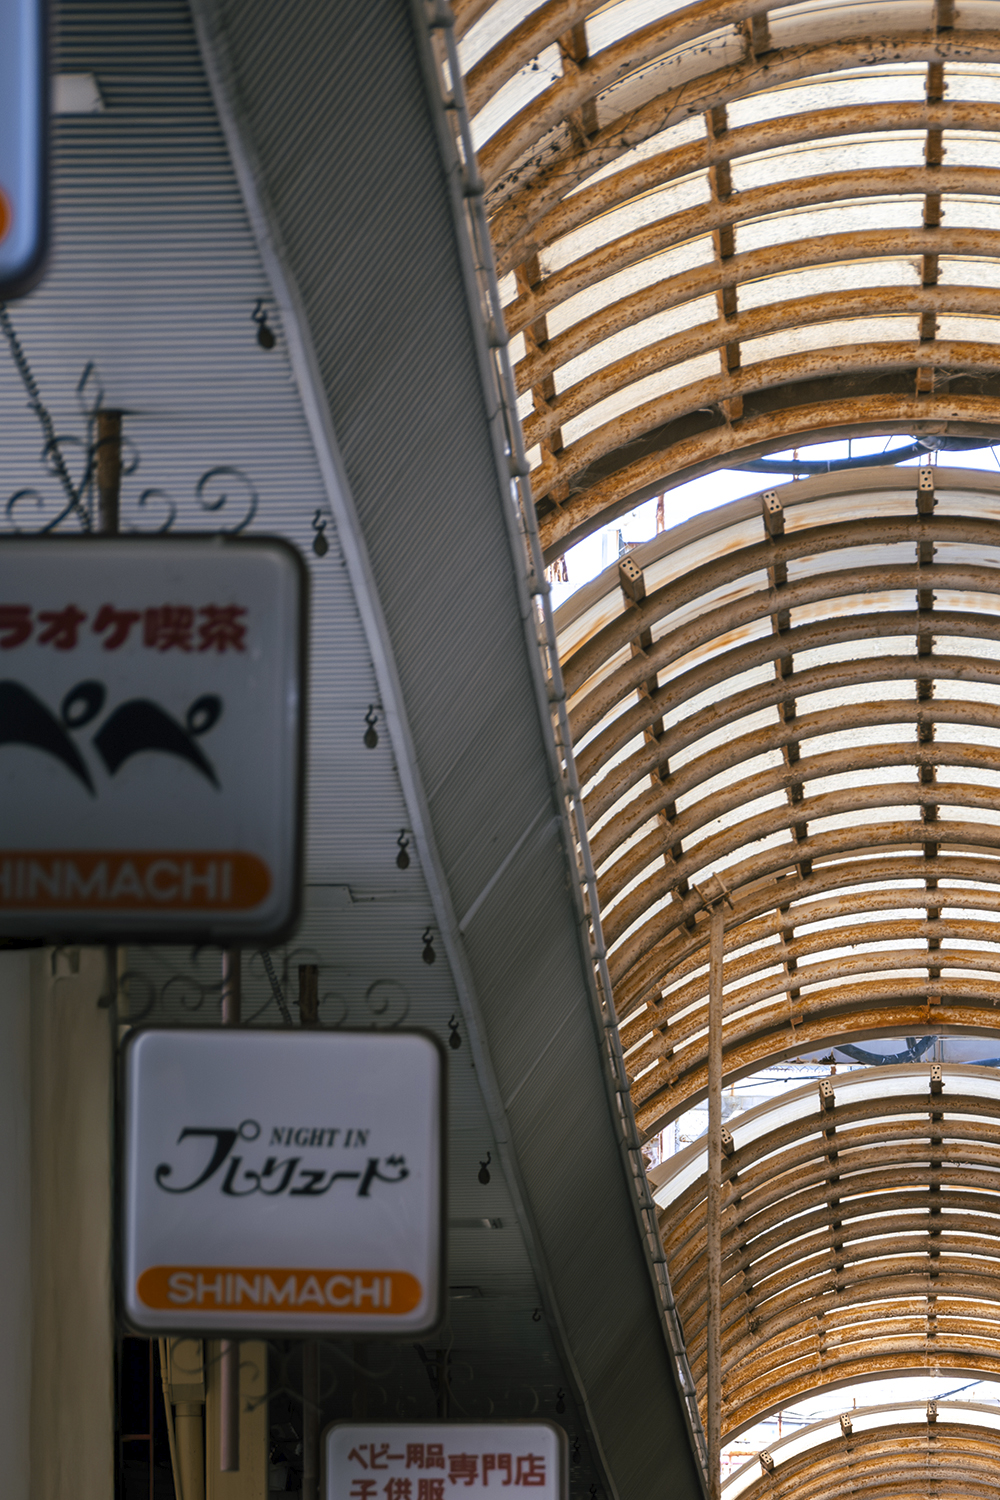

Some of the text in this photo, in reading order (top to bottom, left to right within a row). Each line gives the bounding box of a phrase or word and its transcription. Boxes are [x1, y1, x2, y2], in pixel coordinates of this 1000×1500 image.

[269, 1127, 369, 1147] NIGHT IN
[167, 1271, 392, 1309] SHINMACHI
[348, 1443, 445, 1469] ベビー用品
[447, 1453, 546, 1486] 専門店
